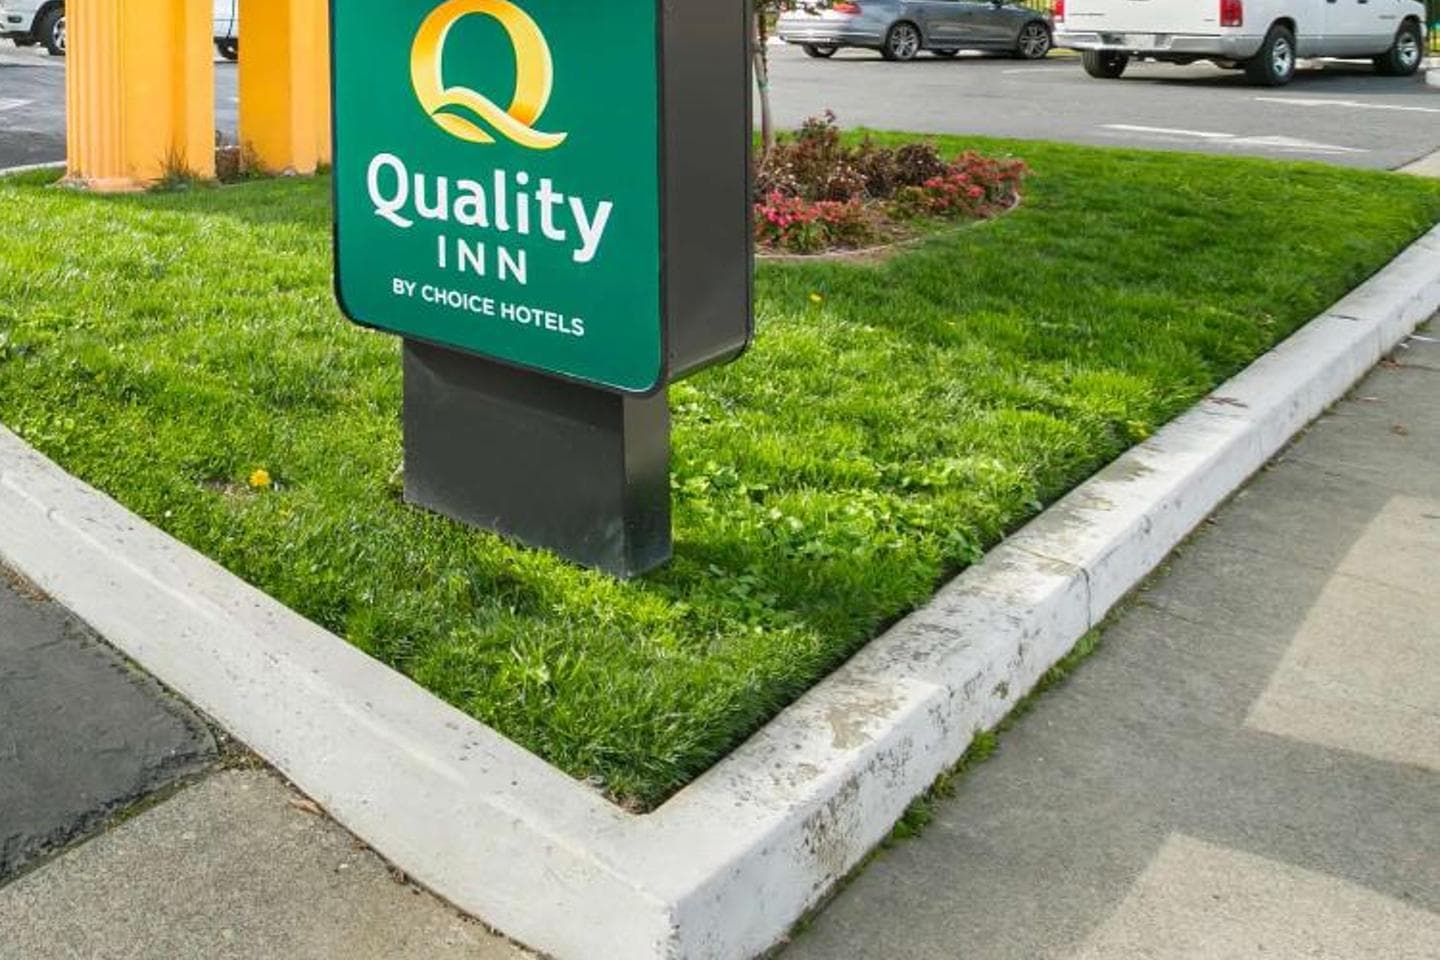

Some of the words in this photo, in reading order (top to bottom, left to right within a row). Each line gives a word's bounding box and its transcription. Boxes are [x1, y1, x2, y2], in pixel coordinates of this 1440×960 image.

[367, 153, 613, 263] Quality
[438, 235, 527, 285] INN
[393, 278, 416, 296] BY
[422, 285, 495, 315] CHOICE
[501, 302, 585, 336] HOTELS
